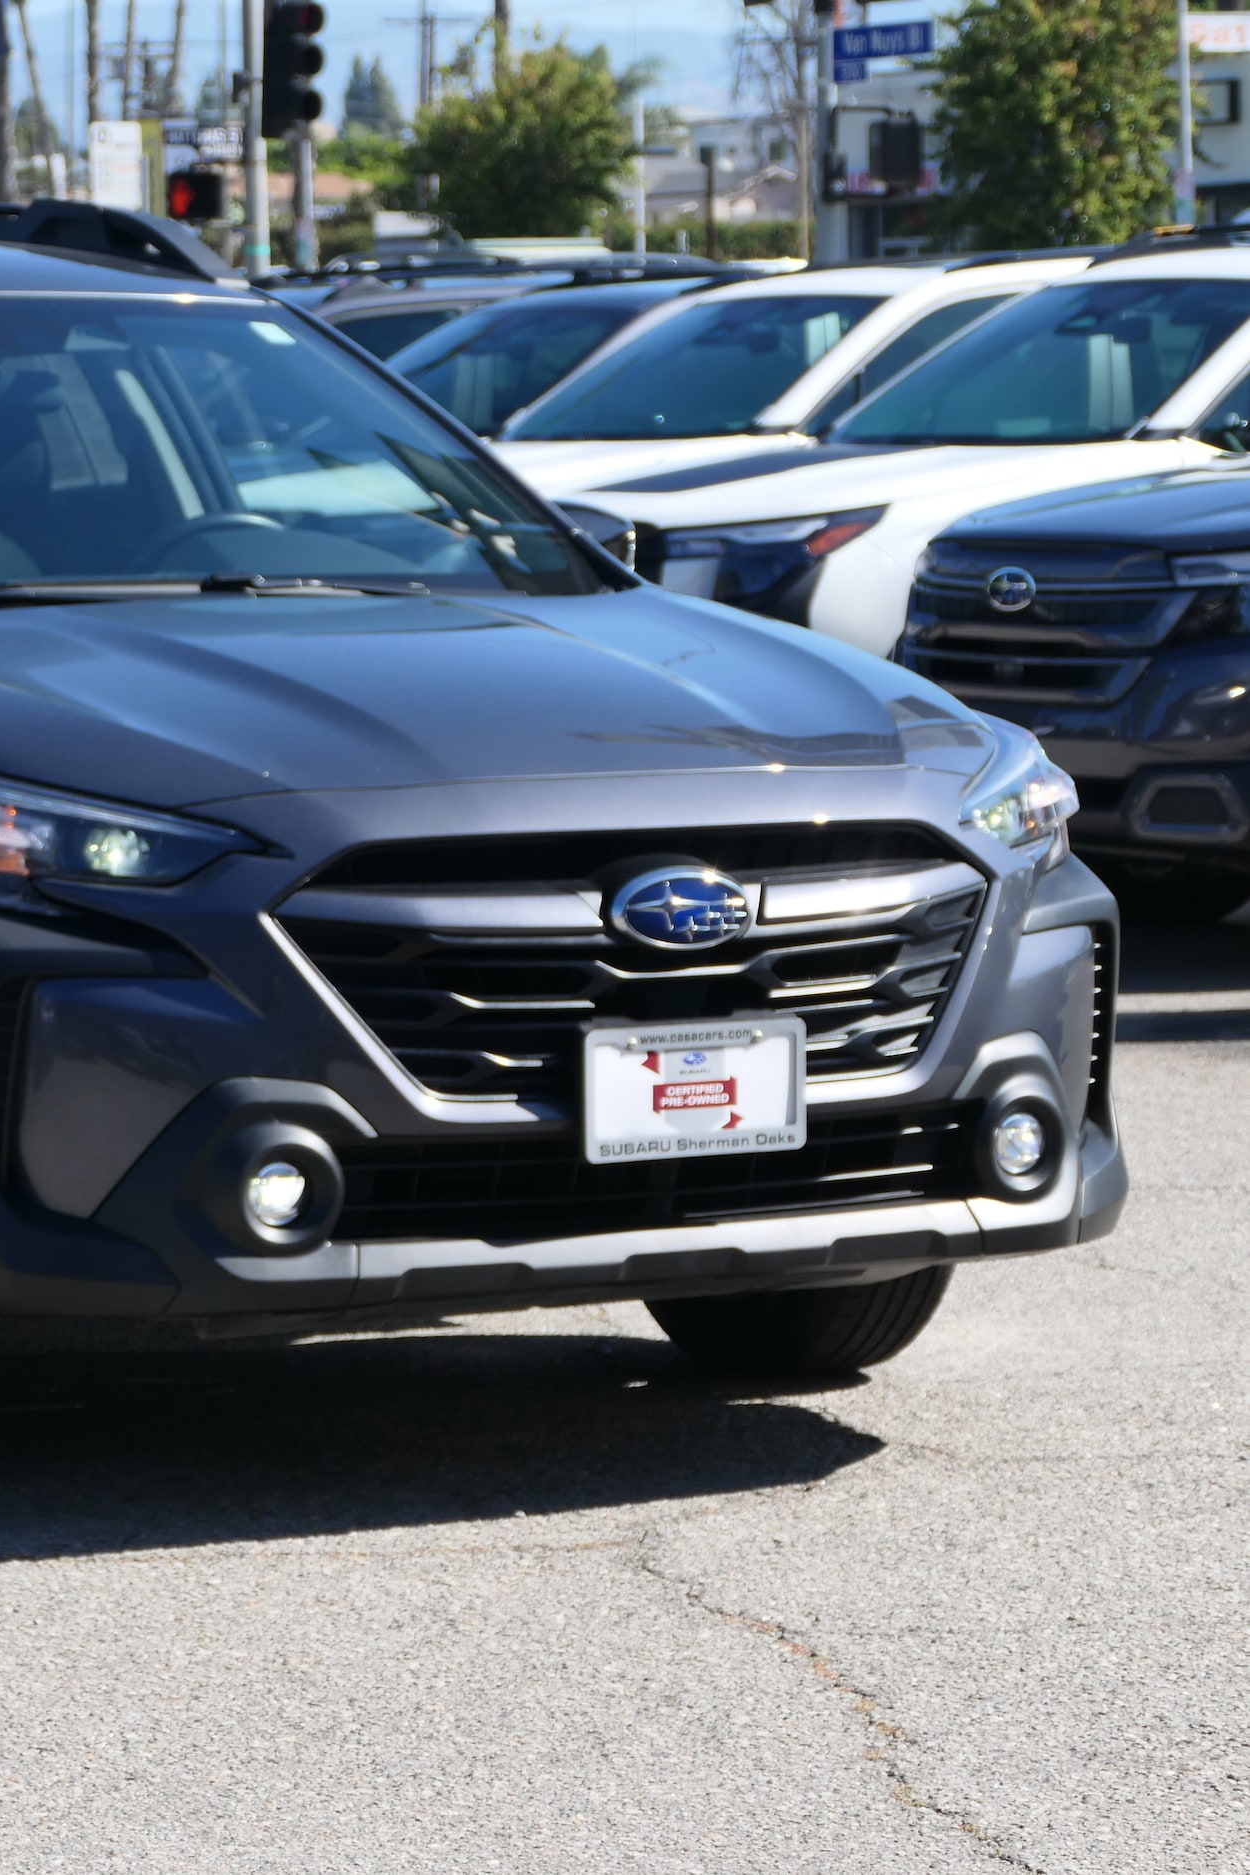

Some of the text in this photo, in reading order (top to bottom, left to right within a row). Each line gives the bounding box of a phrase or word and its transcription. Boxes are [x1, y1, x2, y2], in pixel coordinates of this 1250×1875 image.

[844, 33, 867, 55] Van
[872, 29, 905, 55] Nuys
[640, 1028, 753, 1046] www.casacars.com
[665, 1083, 724, 1097] CERTIFIED
[660, 1093, 730, 1108] PRE-OWNED
[600, 1131, 796, 1157] SUBARU Sherman Oaks
